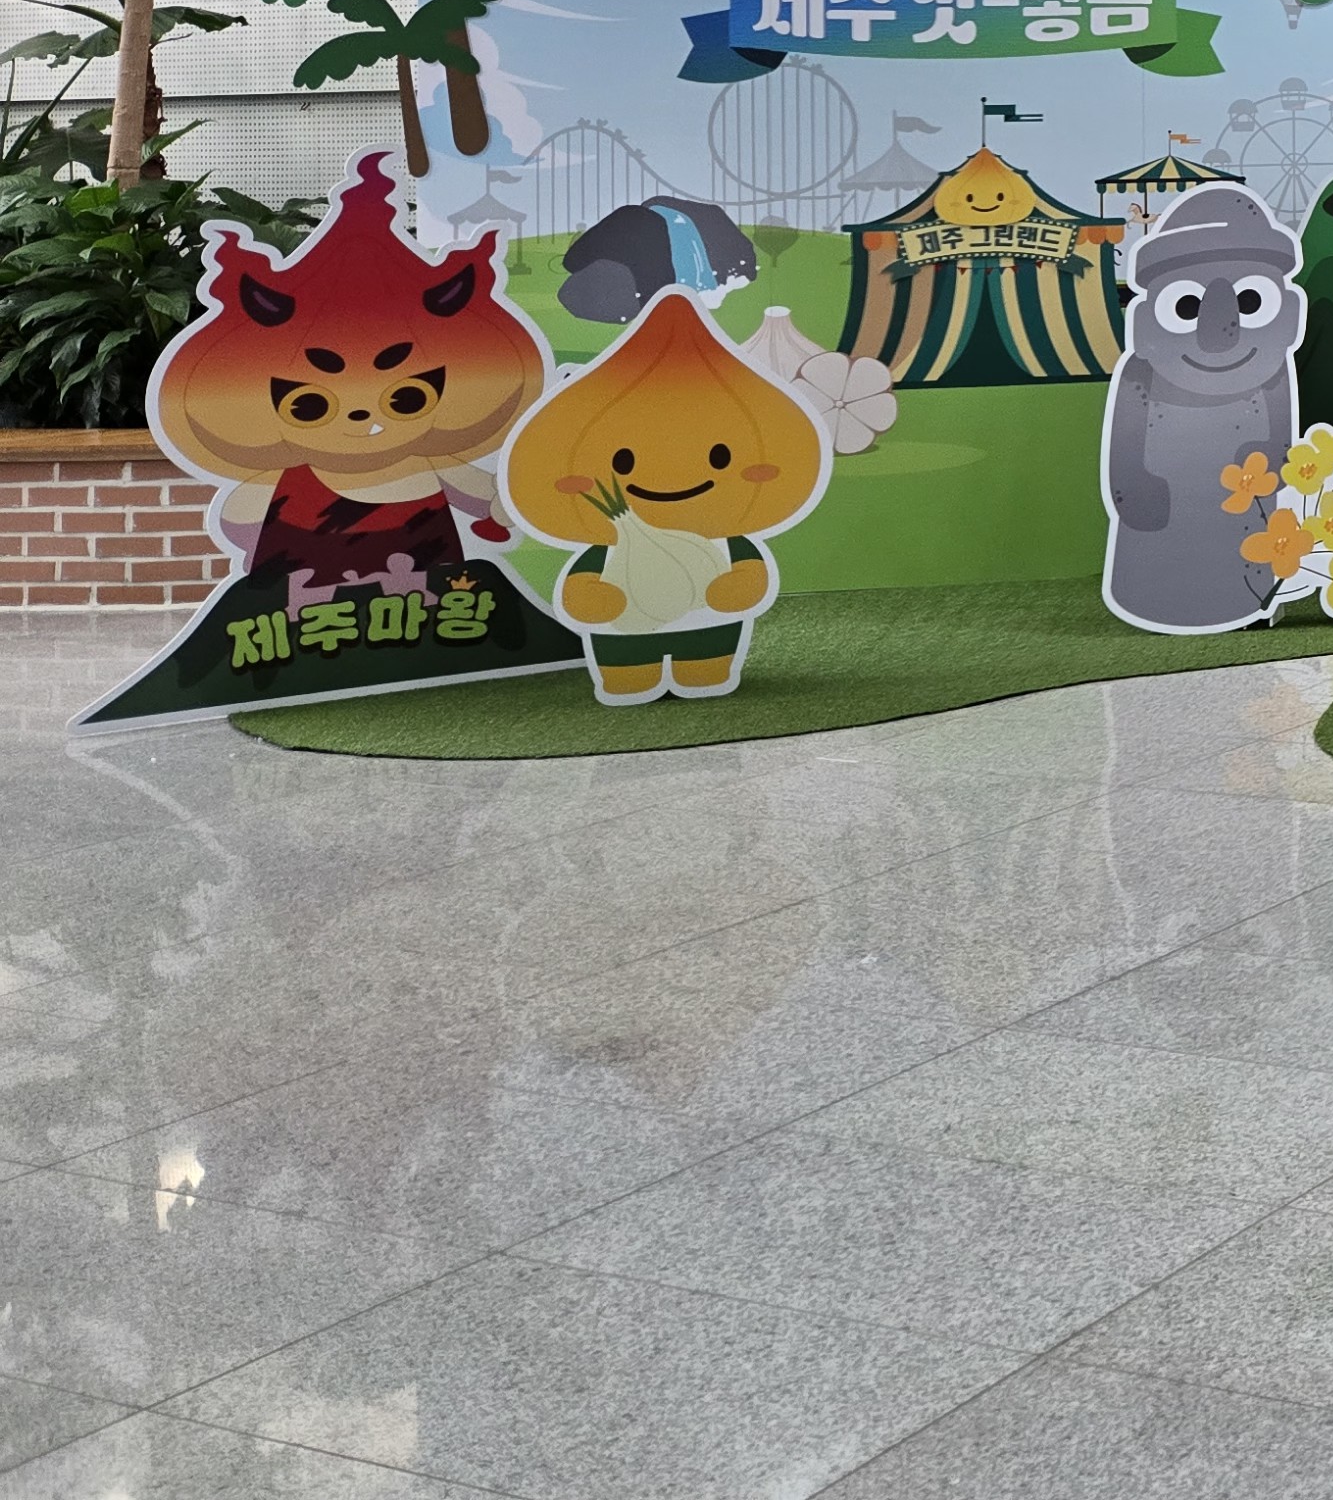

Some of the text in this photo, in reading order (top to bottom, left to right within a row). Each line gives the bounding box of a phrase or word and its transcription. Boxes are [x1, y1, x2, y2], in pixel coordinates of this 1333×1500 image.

[916, 225, 1061, 255] 제주 그린랜드
[226, 590, 497, 668] 제주마왕
